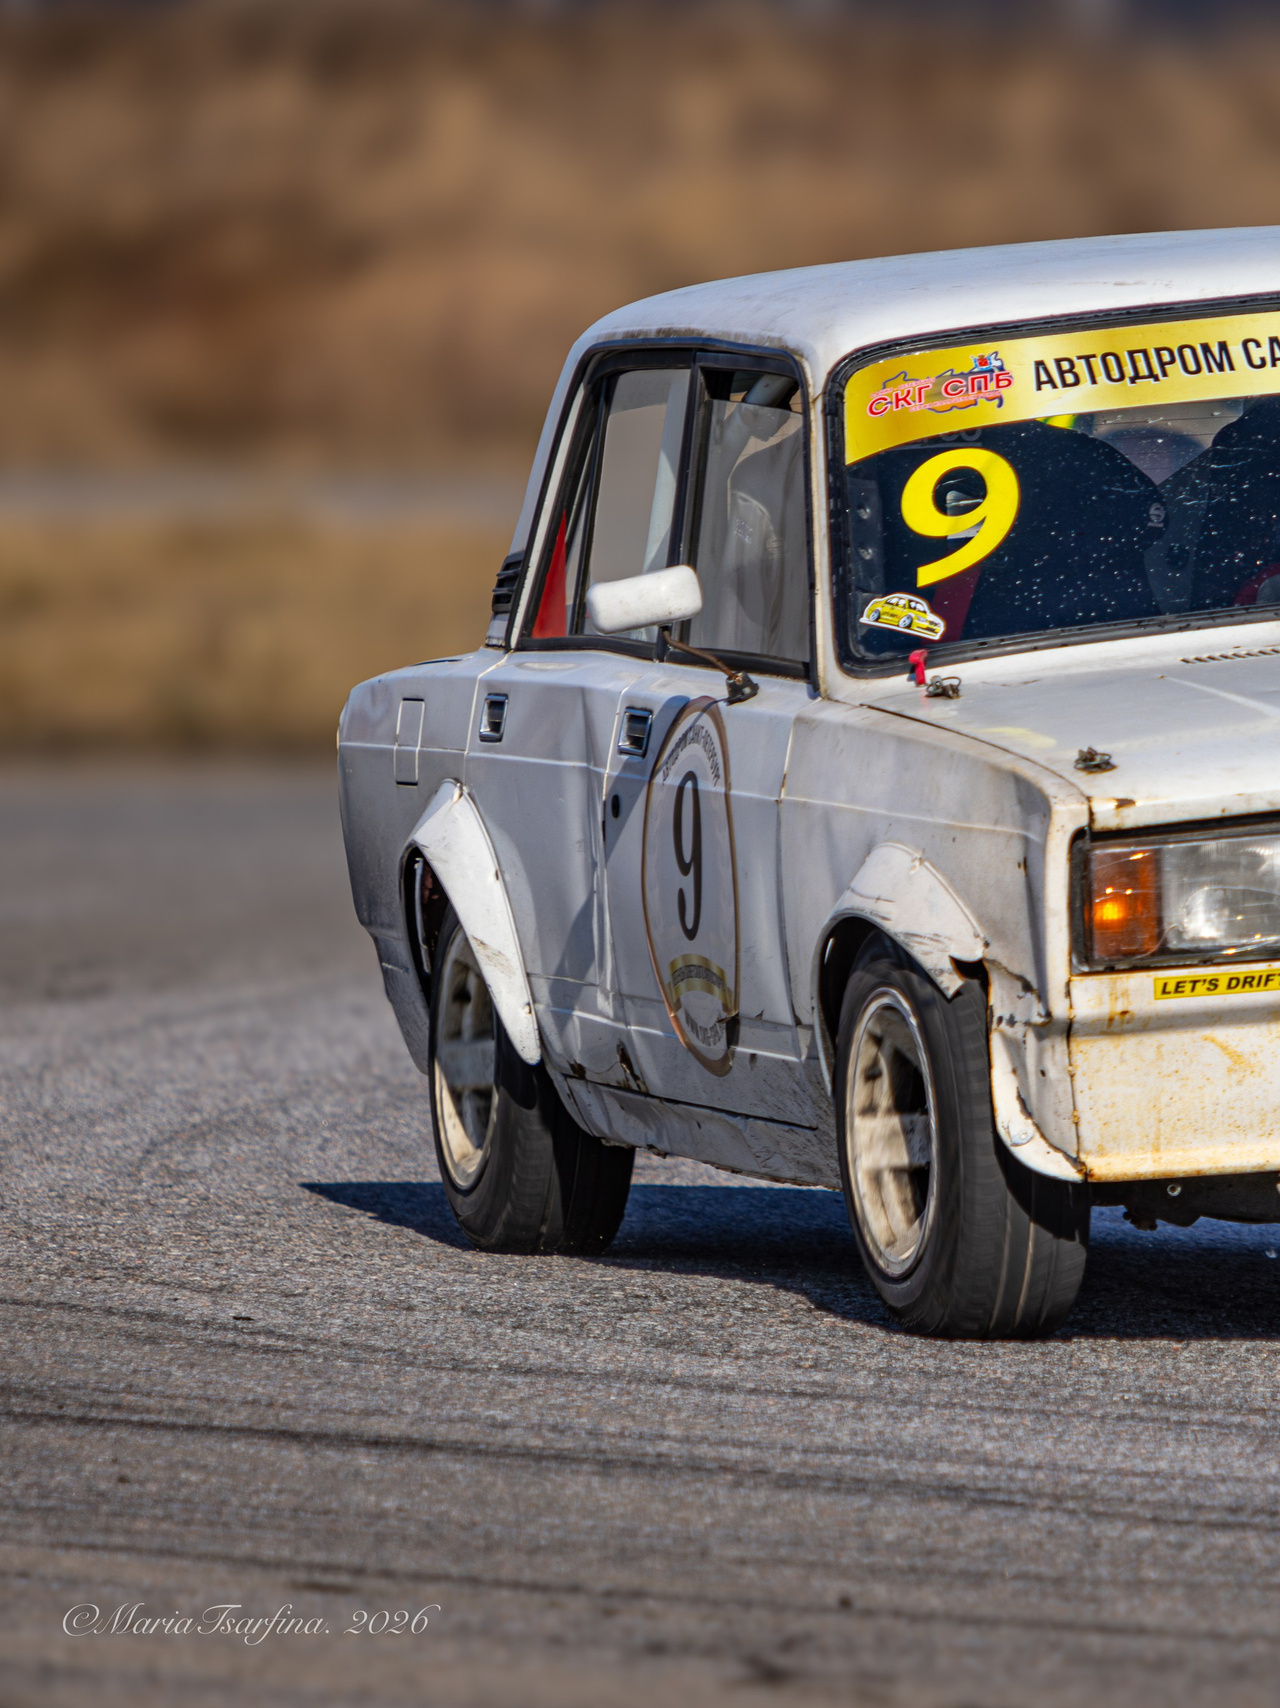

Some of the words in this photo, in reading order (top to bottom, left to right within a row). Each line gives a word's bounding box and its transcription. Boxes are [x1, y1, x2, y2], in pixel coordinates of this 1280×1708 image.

[1033, 340, 1236, 392] АВТОДРОМ
[867, 384, 932, 417] СКГ
[941, 370, 1014, 398] СПБ
[901, 447, 1021, 588] 9
[673, 771, 703, 941] 9
[1160, 977, 1219, 996] LET'S
